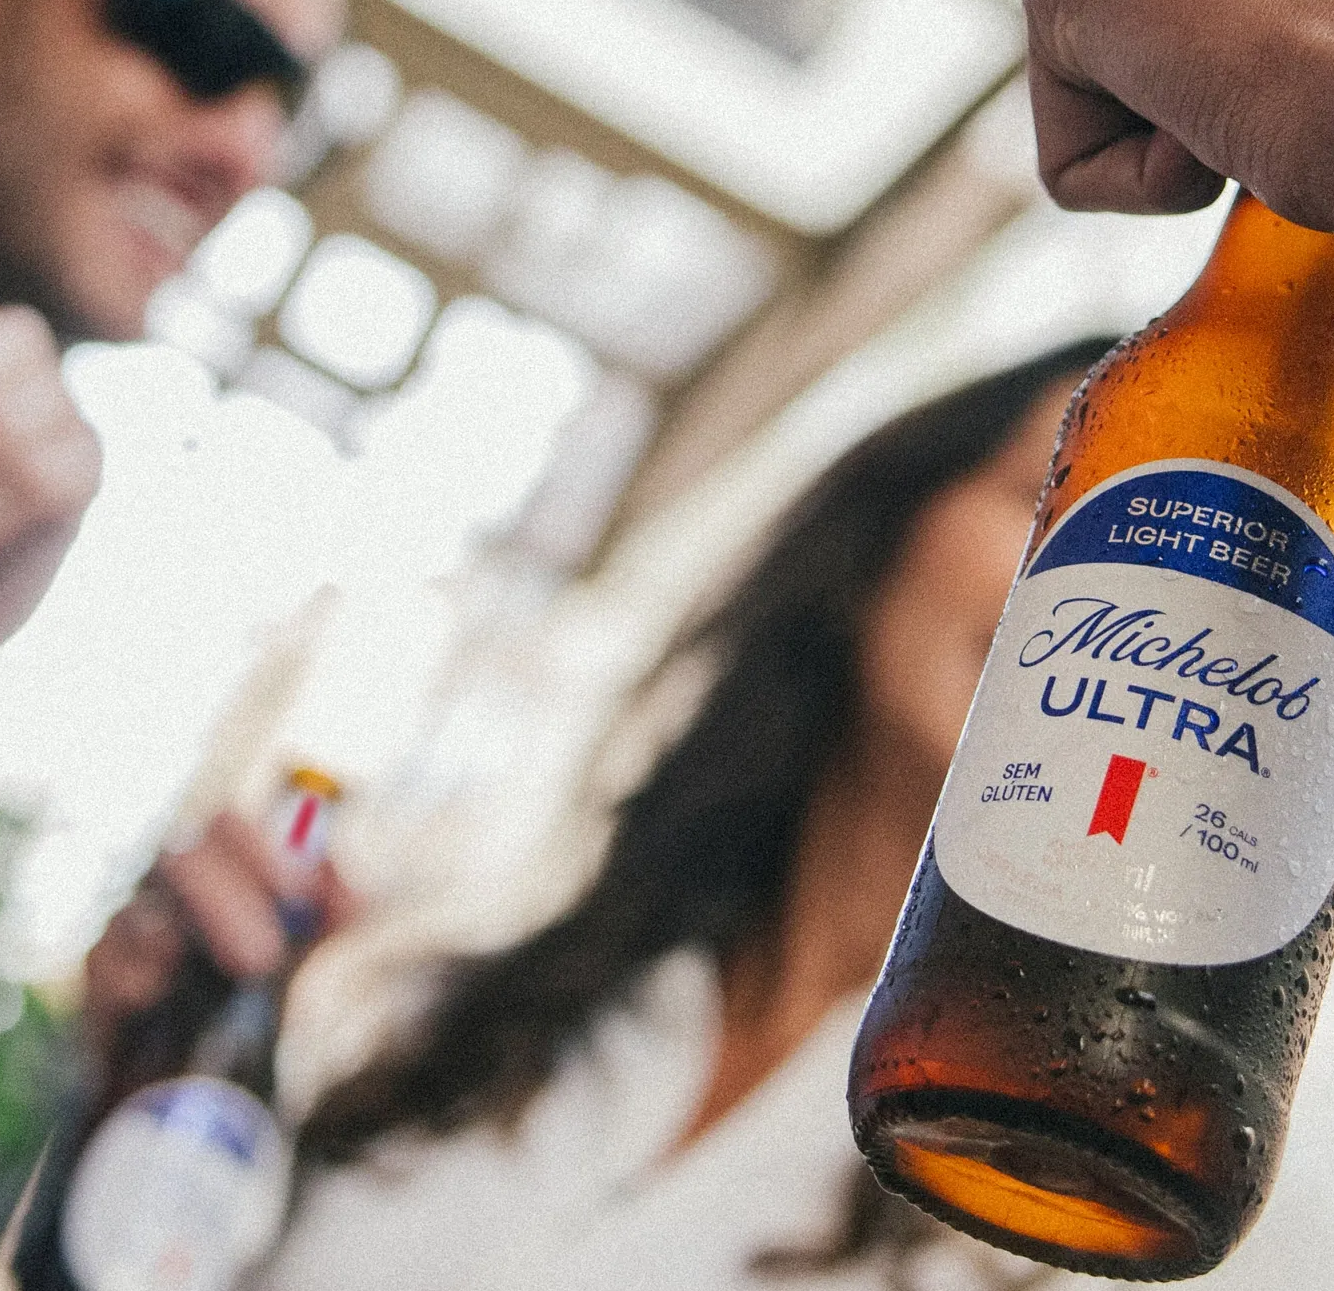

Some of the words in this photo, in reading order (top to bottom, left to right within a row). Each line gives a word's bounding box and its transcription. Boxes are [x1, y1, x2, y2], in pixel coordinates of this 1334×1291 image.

[1127, 497, 1289, 552] SUPERIOR
[1108, 524, 1205, 553] LIGHT
[1209, 539, 1292, 588] BEER
[1019, 597, 1321, 721] Michelob
[981, 780, 1053, 802] GLÚTEN
[1002, 762, 1042, 779] SEM
[1194, 803, 1227, 829] 26
[1229, 826, 1258, 847] CALS
[1240, 857, 1259, 873] ml
